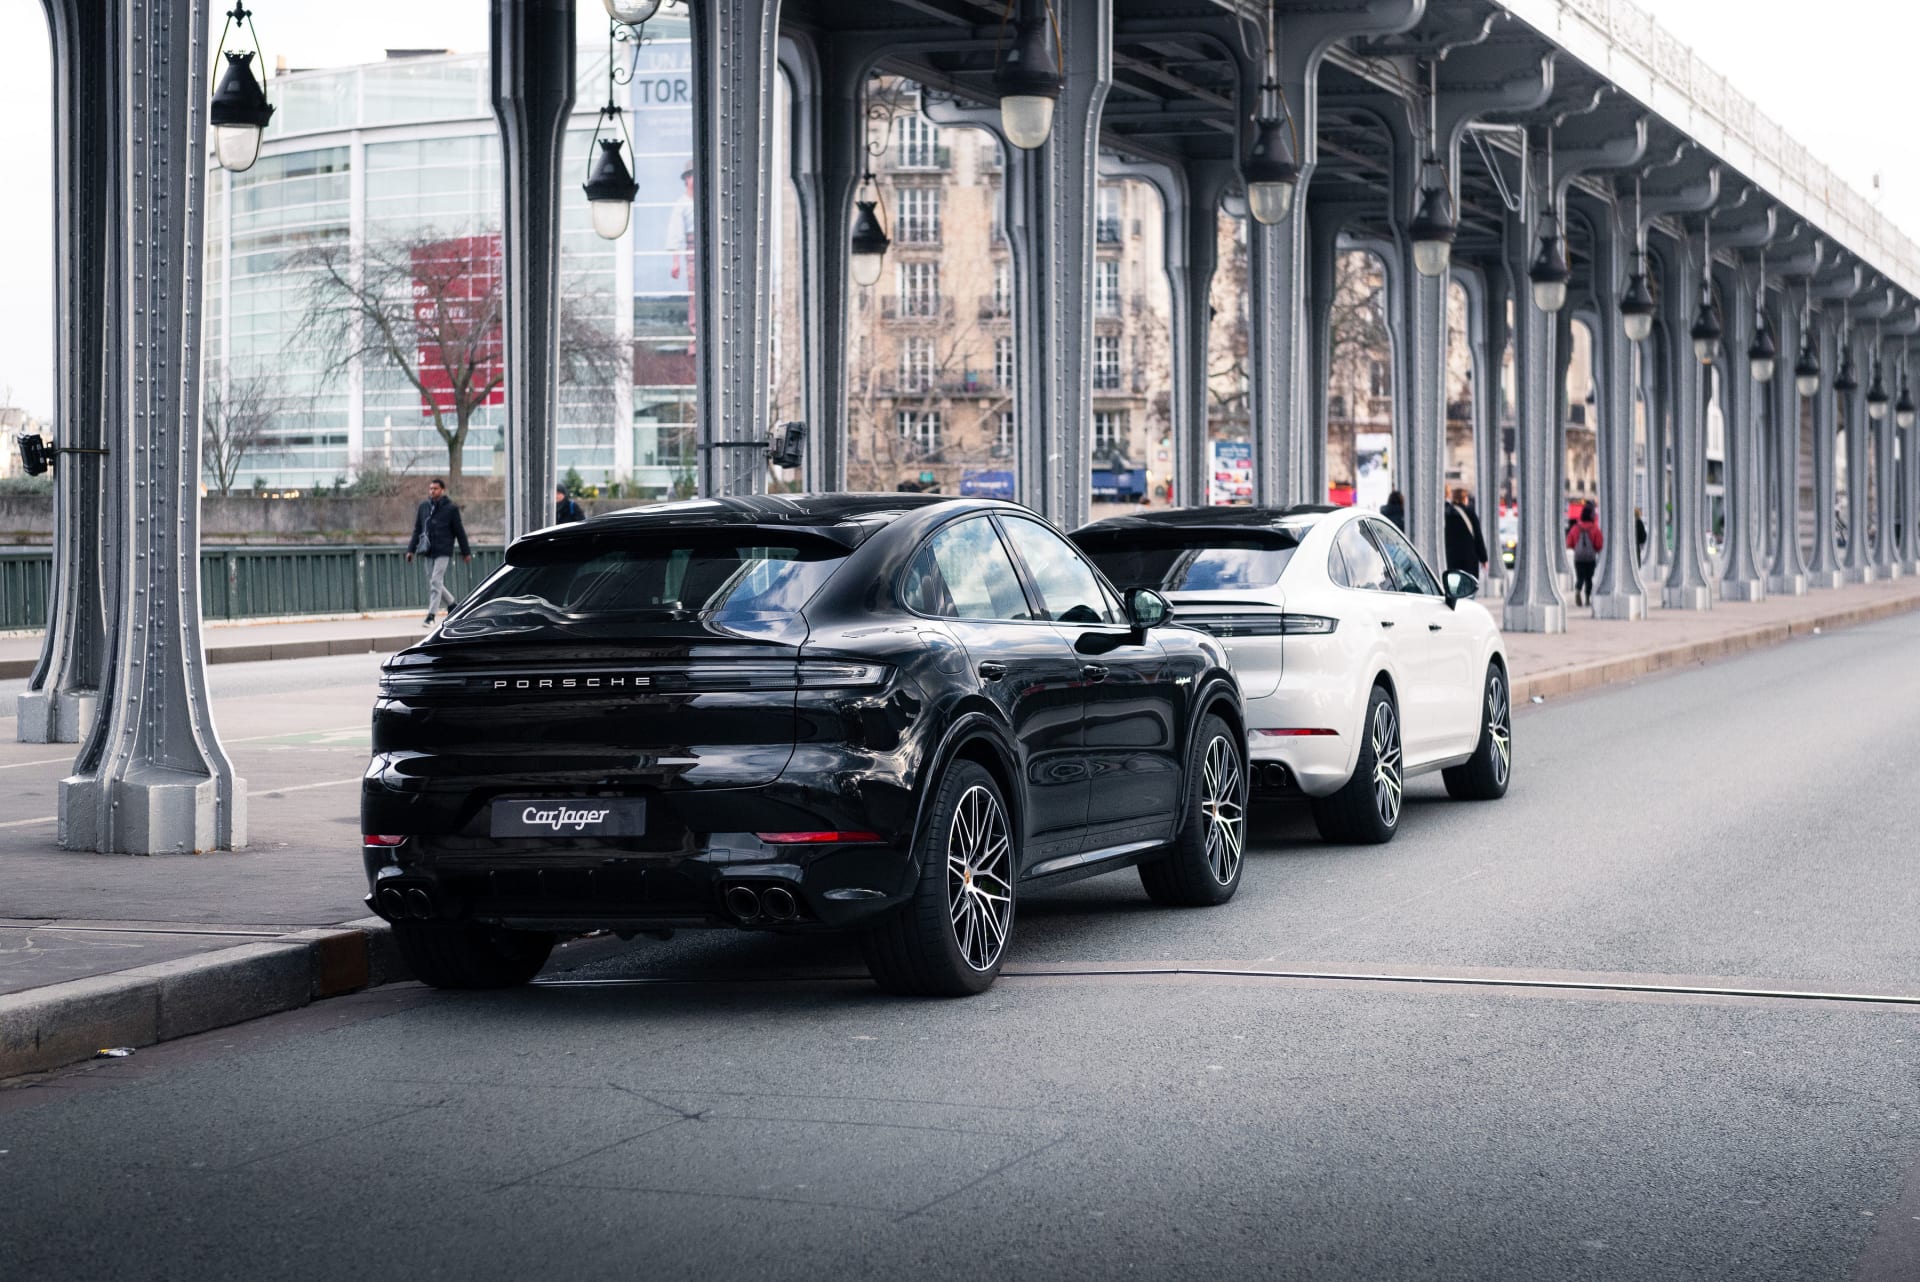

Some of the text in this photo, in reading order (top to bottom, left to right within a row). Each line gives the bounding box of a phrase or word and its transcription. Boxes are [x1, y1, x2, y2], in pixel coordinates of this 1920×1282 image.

[639, 78, 692, 104] TOR
[493, 677, 650, 689] PORSCHE
[522, 806, 609, 831] CarJager
